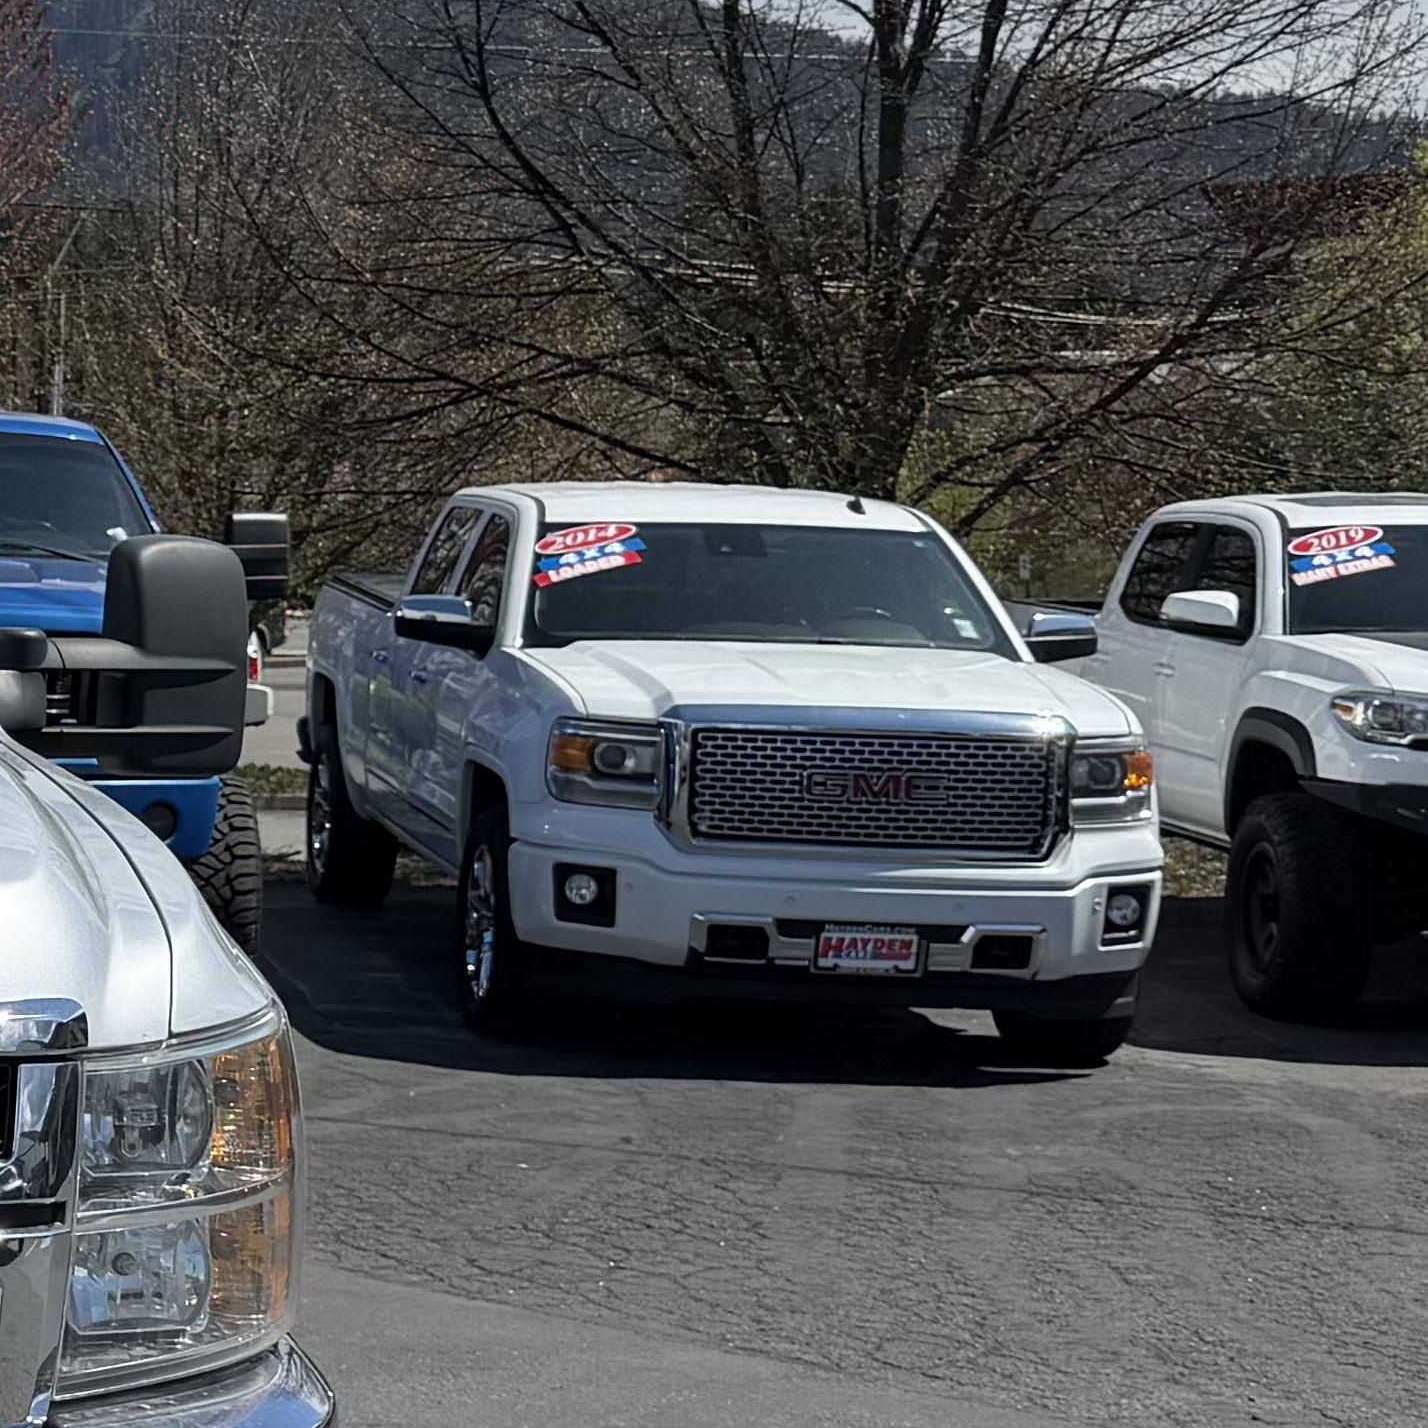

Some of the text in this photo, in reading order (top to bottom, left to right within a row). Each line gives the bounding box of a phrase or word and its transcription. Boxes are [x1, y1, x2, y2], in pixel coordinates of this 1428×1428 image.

[551, 524, 617, 552] 2014
[1307, 527, 1365, 552] 2019
[802, 771, 950, 804] GMC
[820, 936, 914, 959] HAYDEN
